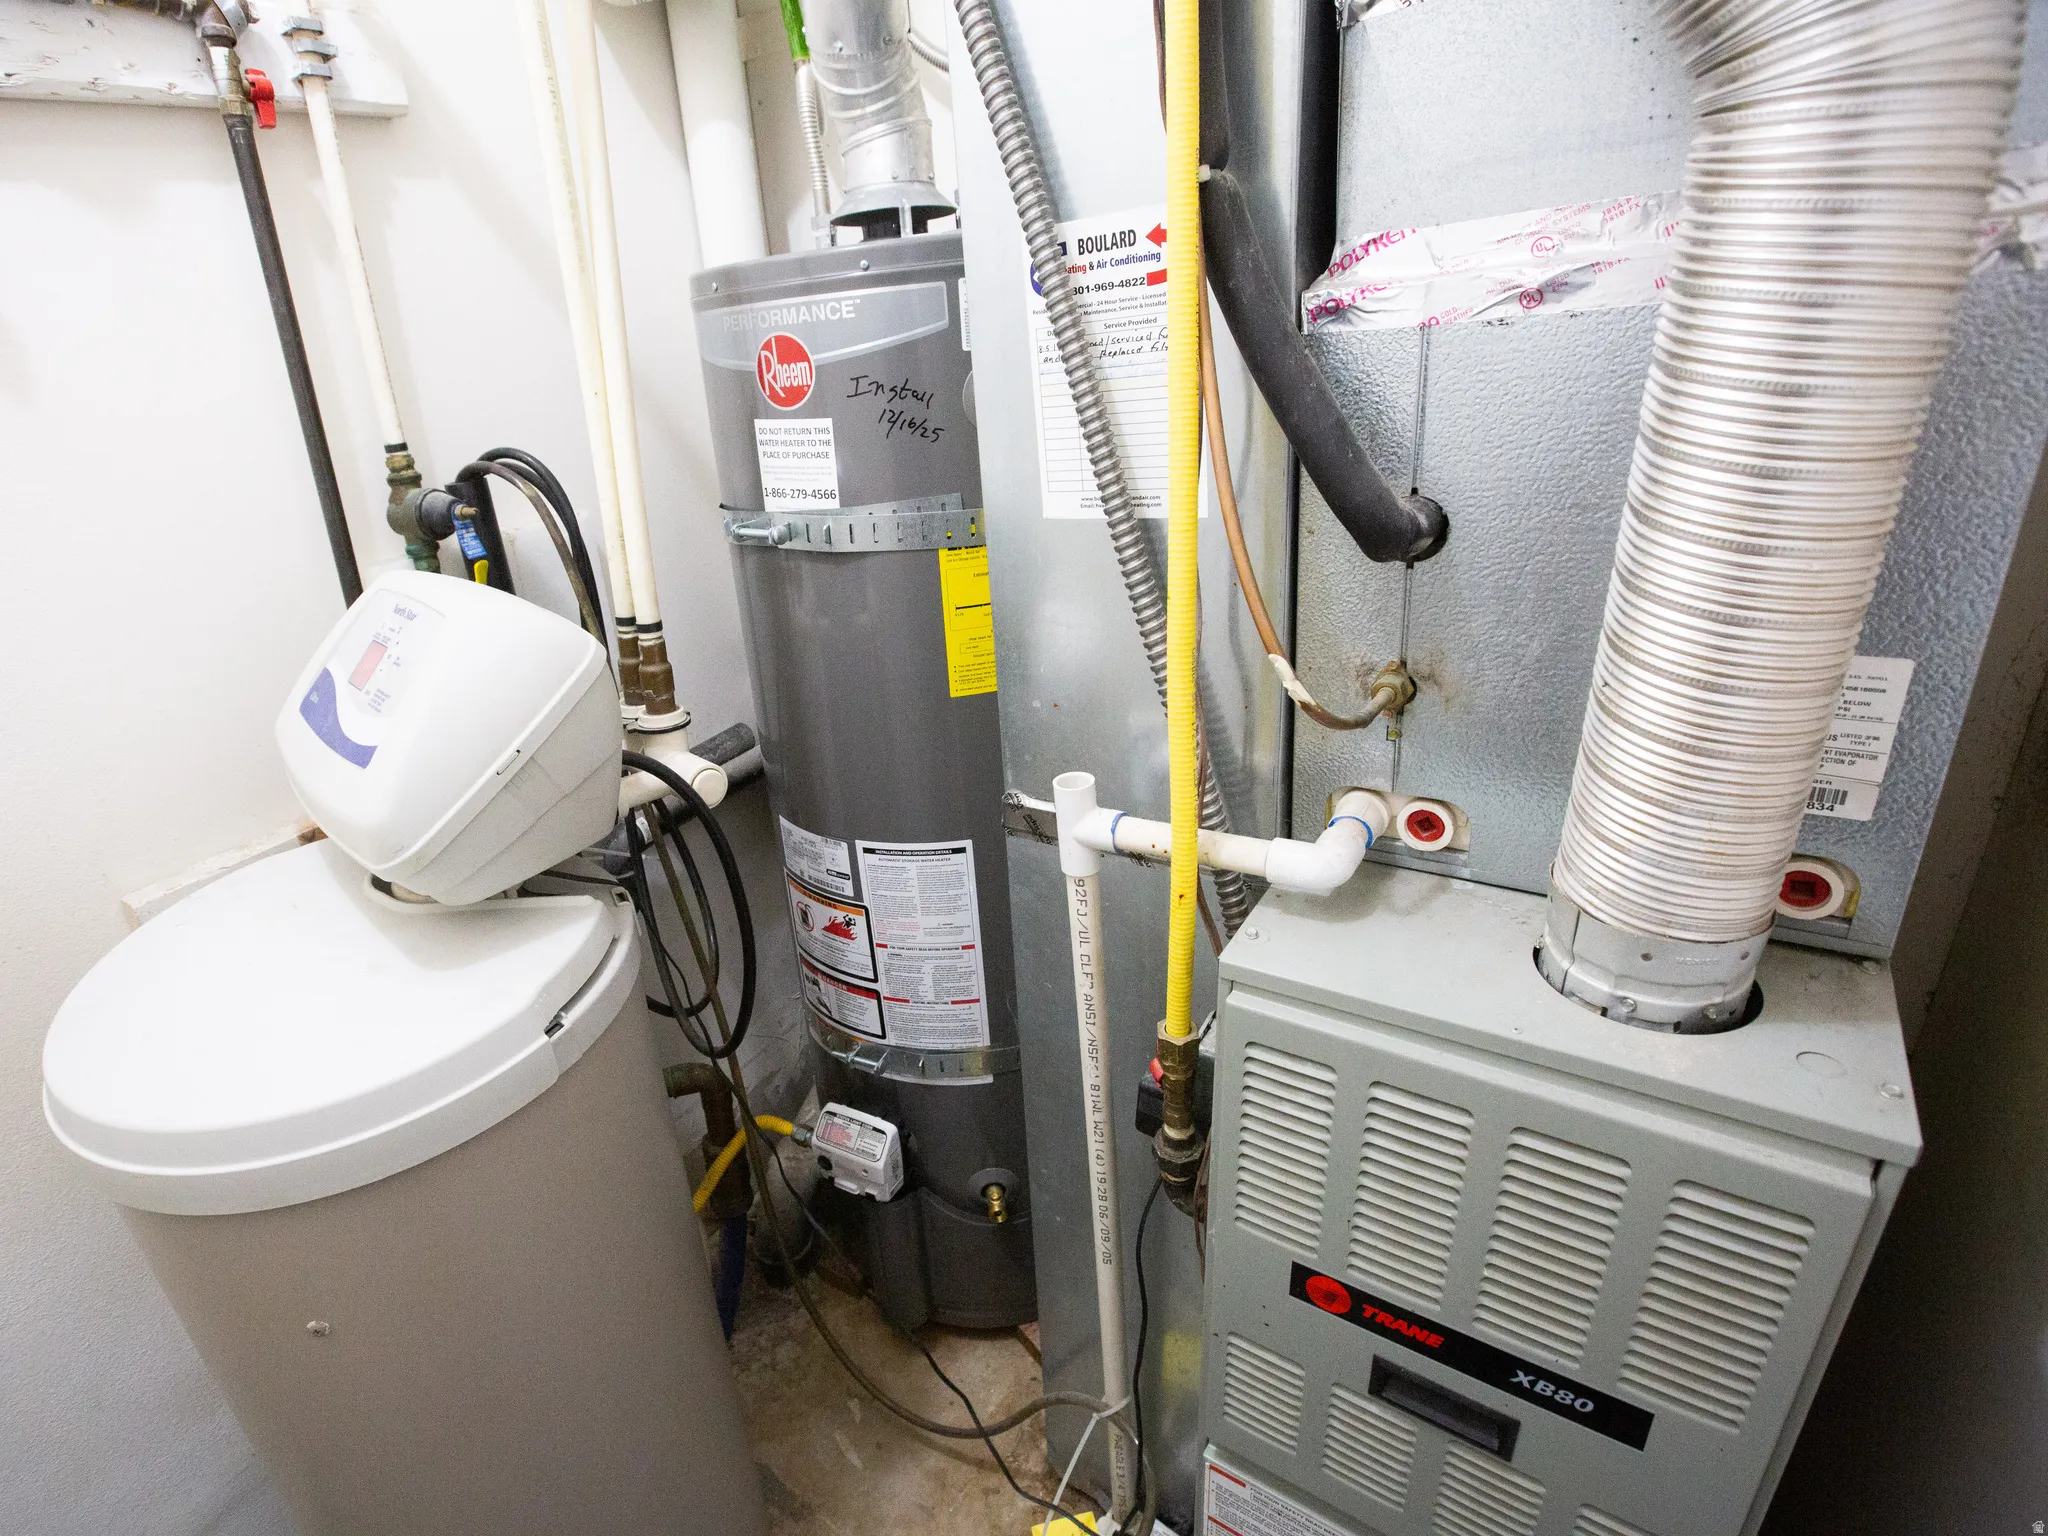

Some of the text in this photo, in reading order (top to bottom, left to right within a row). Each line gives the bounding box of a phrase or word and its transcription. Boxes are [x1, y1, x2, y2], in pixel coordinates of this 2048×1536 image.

[1077, 229, 1137, 256] BOULARD
[1088, 261, 1095, 272] &
[1096, 257, 1107, 270] Air
[1110, 250, 1161, 268] Conditioning
[1104, 298, 1118, 306] Hour
[1118, 296, 1138, 304] Service
[1141, 291, 1167, 301] Licensed
[1119, 304, 1138, 312] Service
[1103, 316, 1158, 330] Service Provided
[847, 375, 934, 409] Install
[758, 426, 831, 436] DO NOT RETURN THIS
[879, 408, 945, 443] 12/16/25
[758, 439, 780, 447] WATER
[780, 439, 805, 447] HEATER
[807, 439, 817, 447] TO
[762, 451, 830, 460] PLACE OF PURCHASE
[764, 487, 837, 500] 1-866-279-4566
[1834, 749, 1880, 761] EVAPORATOR
[1847, 759, 1857, 767] OF
[1095, 1148, 1105, 1167] (4)
[1096, 1171, 1107, 1202] 19:28
[1098, 1204, 1112, 1266] 06/09/05
[1362, 1303, 1445, 1349] TRANE
[1509, 1369, 1594, 1413] XB80
